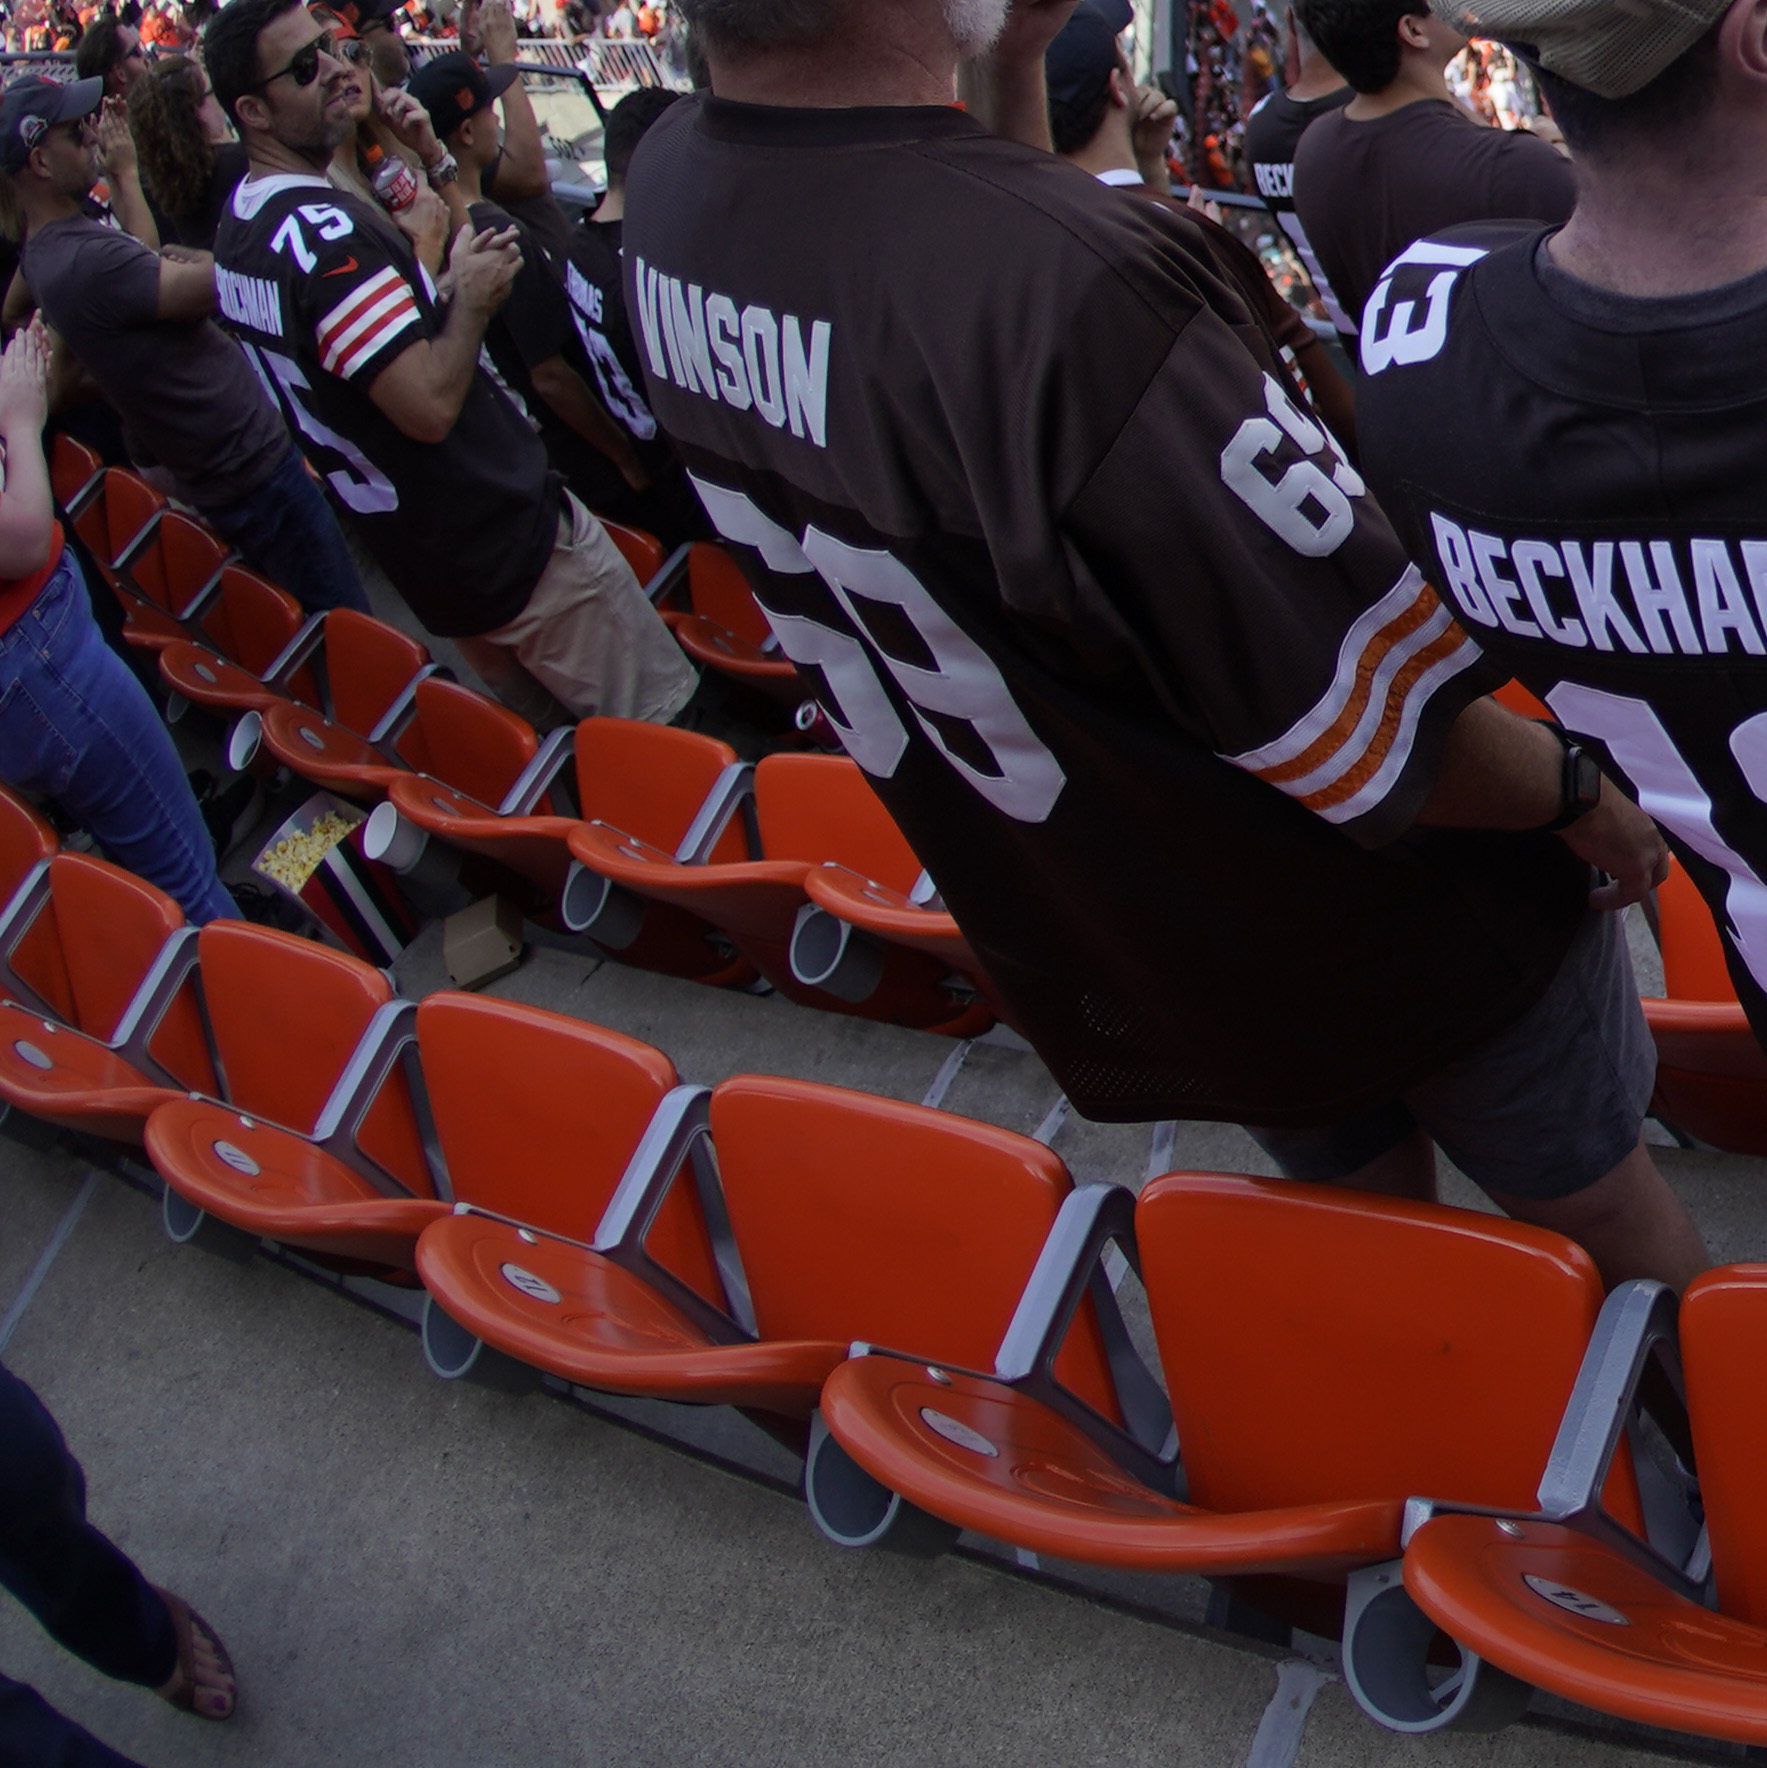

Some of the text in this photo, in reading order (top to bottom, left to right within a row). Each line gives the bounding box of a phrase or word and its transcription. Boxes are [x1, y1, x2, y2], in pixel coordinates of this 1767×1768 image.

[270, 203, 354, 275] 75
[634, 256, 832, 448] VINSON
[1550, 1590, 1600, 1611] 14
